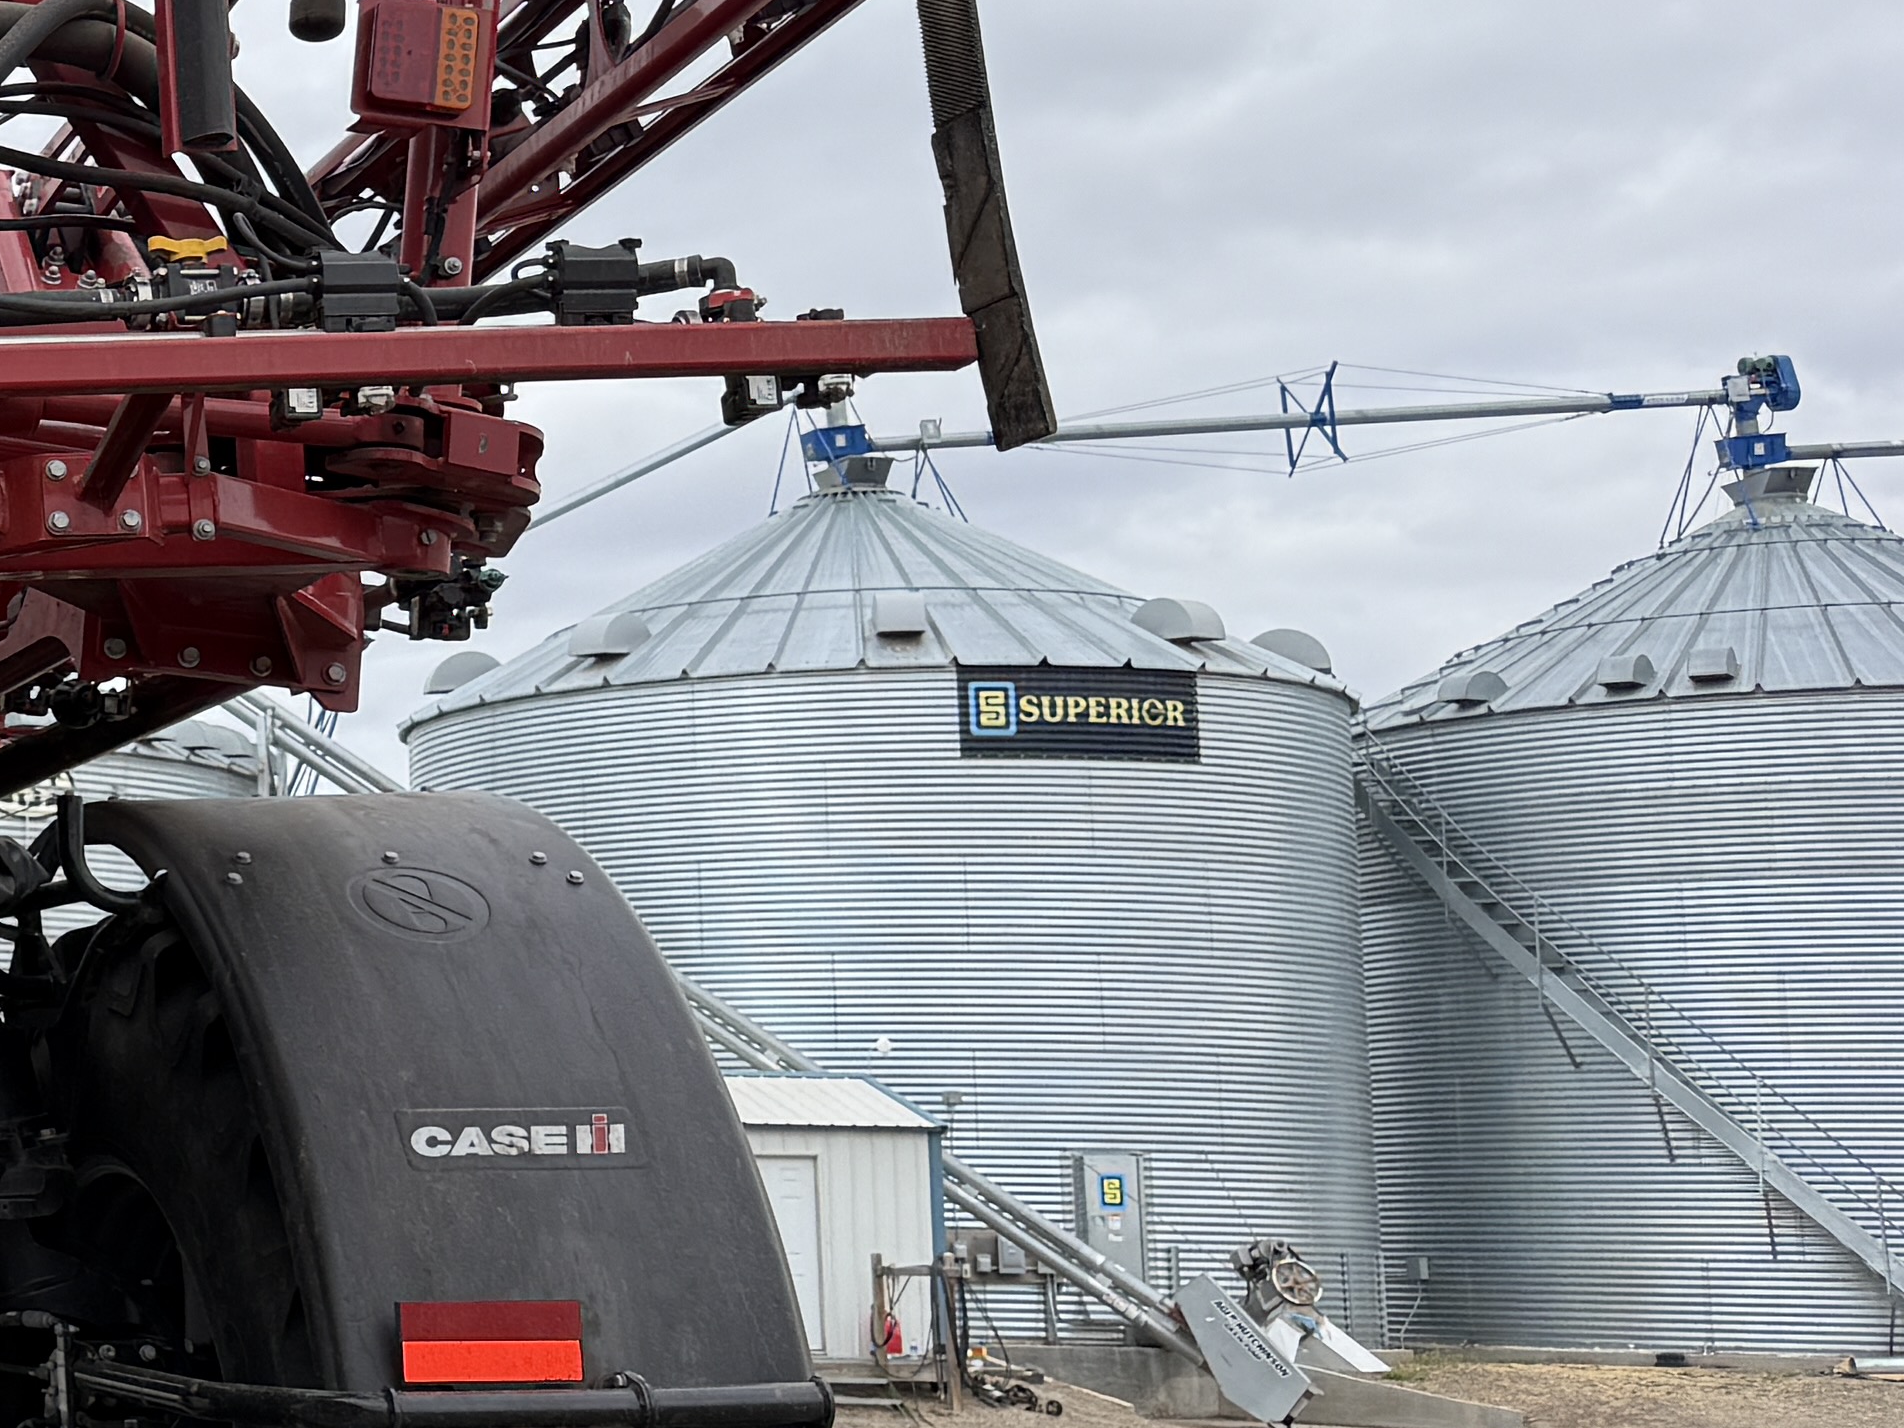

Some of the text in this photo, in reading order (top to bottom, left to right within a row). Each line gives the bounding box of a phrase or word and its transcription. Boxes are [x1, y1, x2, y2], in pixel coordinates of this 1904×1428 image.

[1019, 694, 1186, 727] SUPERIOR
[410, 1125, 568, 1157] CASE
[1236, 1323, 1289, 1376] HUTCHINSON
